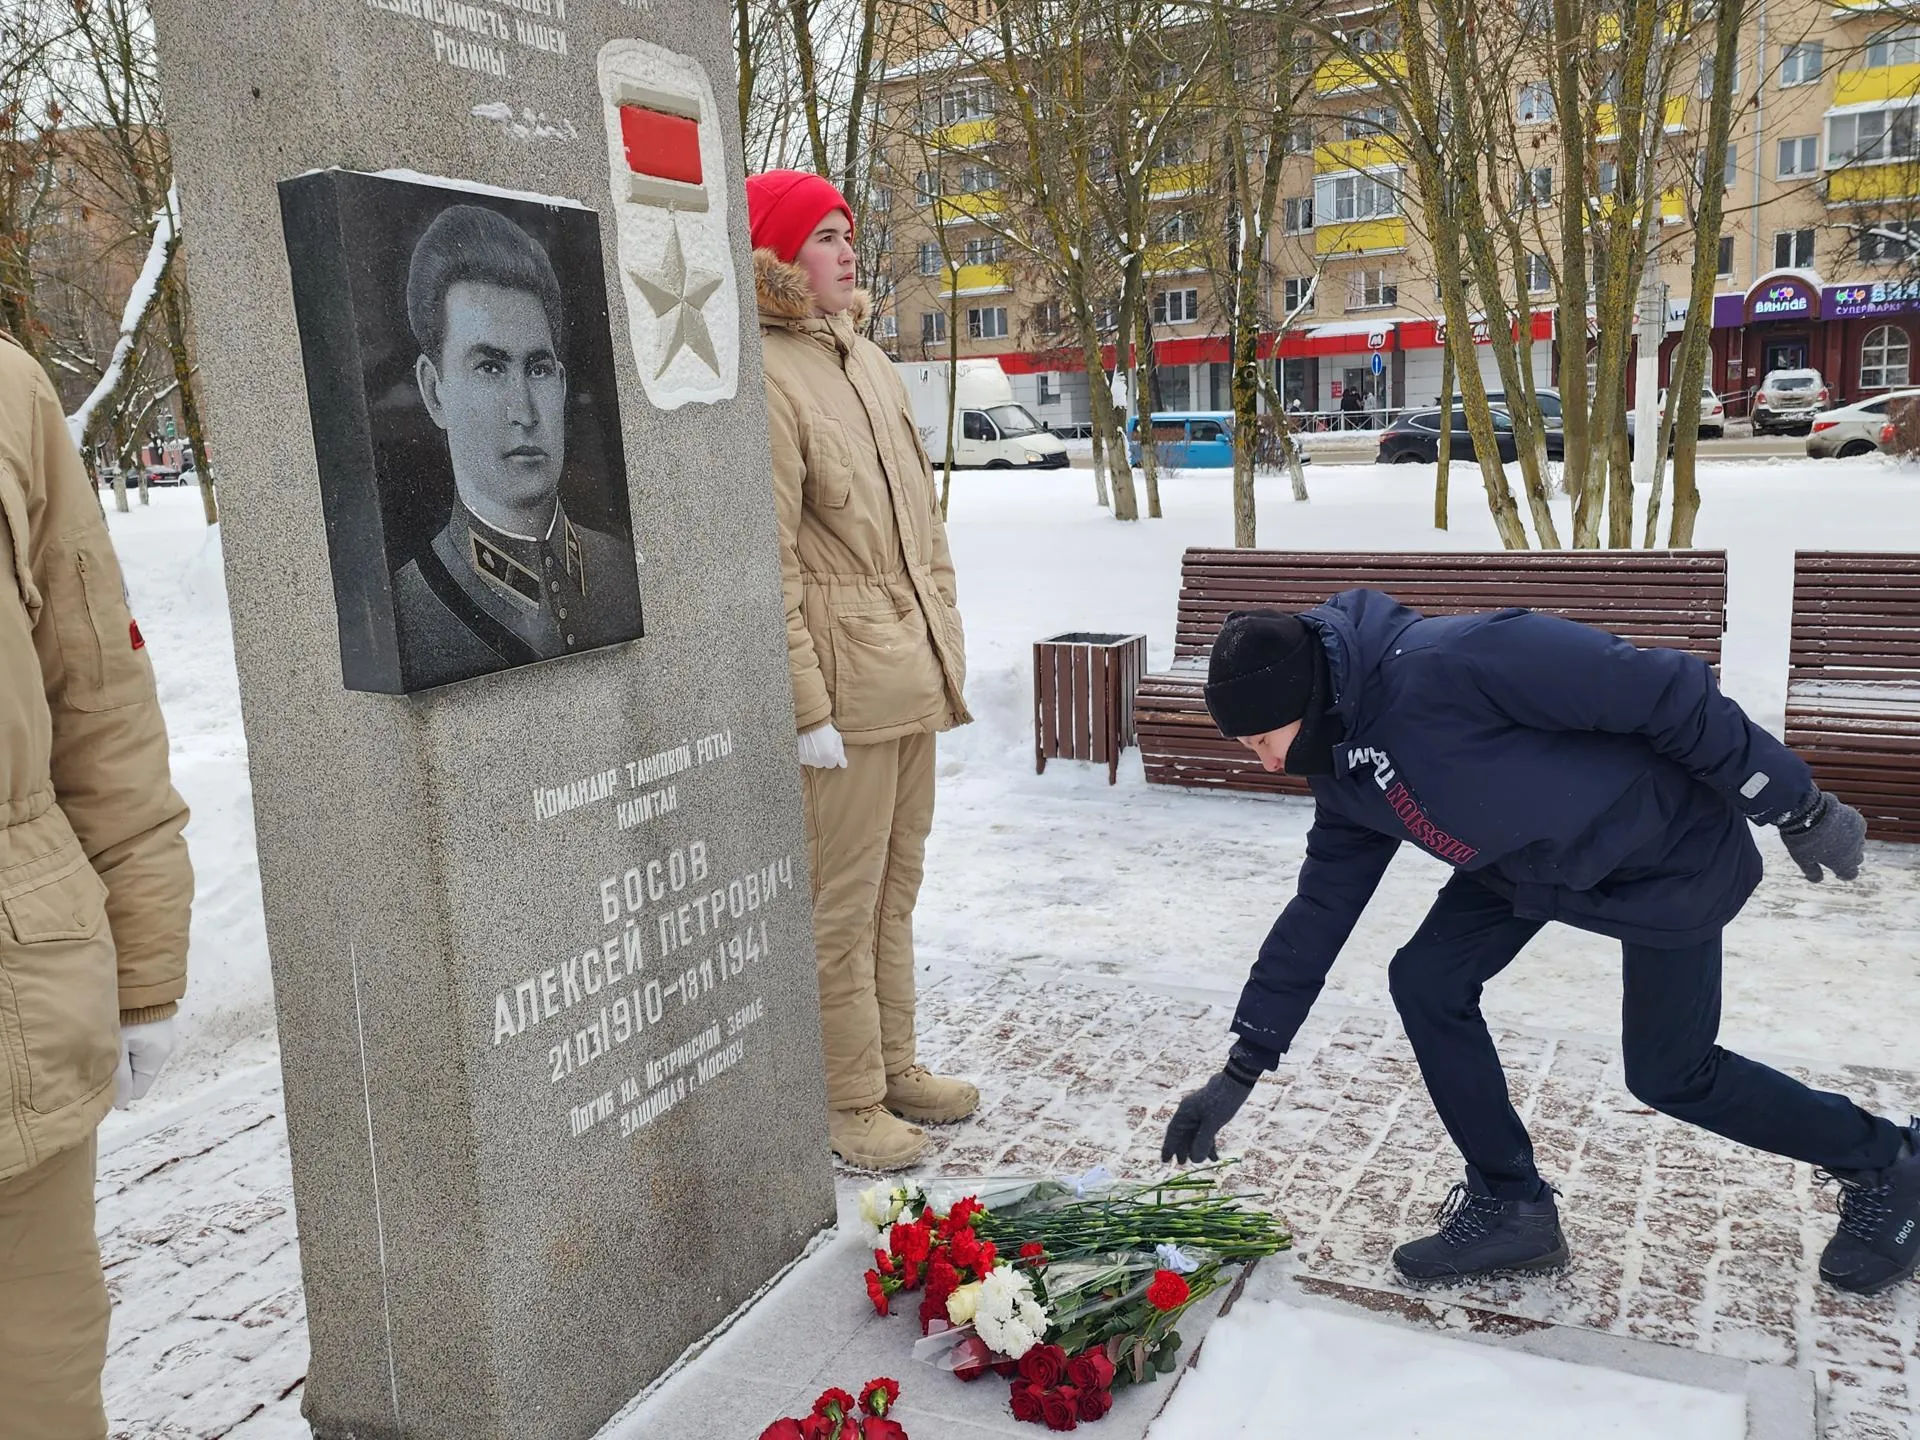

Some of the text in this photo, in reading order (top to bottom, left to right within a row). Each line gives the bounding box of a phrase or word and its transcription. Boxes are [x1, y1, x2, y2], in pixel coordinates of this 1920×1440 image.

[366, 0, 509, 39] ЗАВИСИМОСТЬ
[1835, 301, 1906, 315] СУПЕРМАРКЕ
[1385, 782, 1479, 865] MISSION
[600, 839, 708, 925] БОСОВ
[493, 854, 793, 1046] АЛЕКСЕЙ ПЕТРОВИЧ
